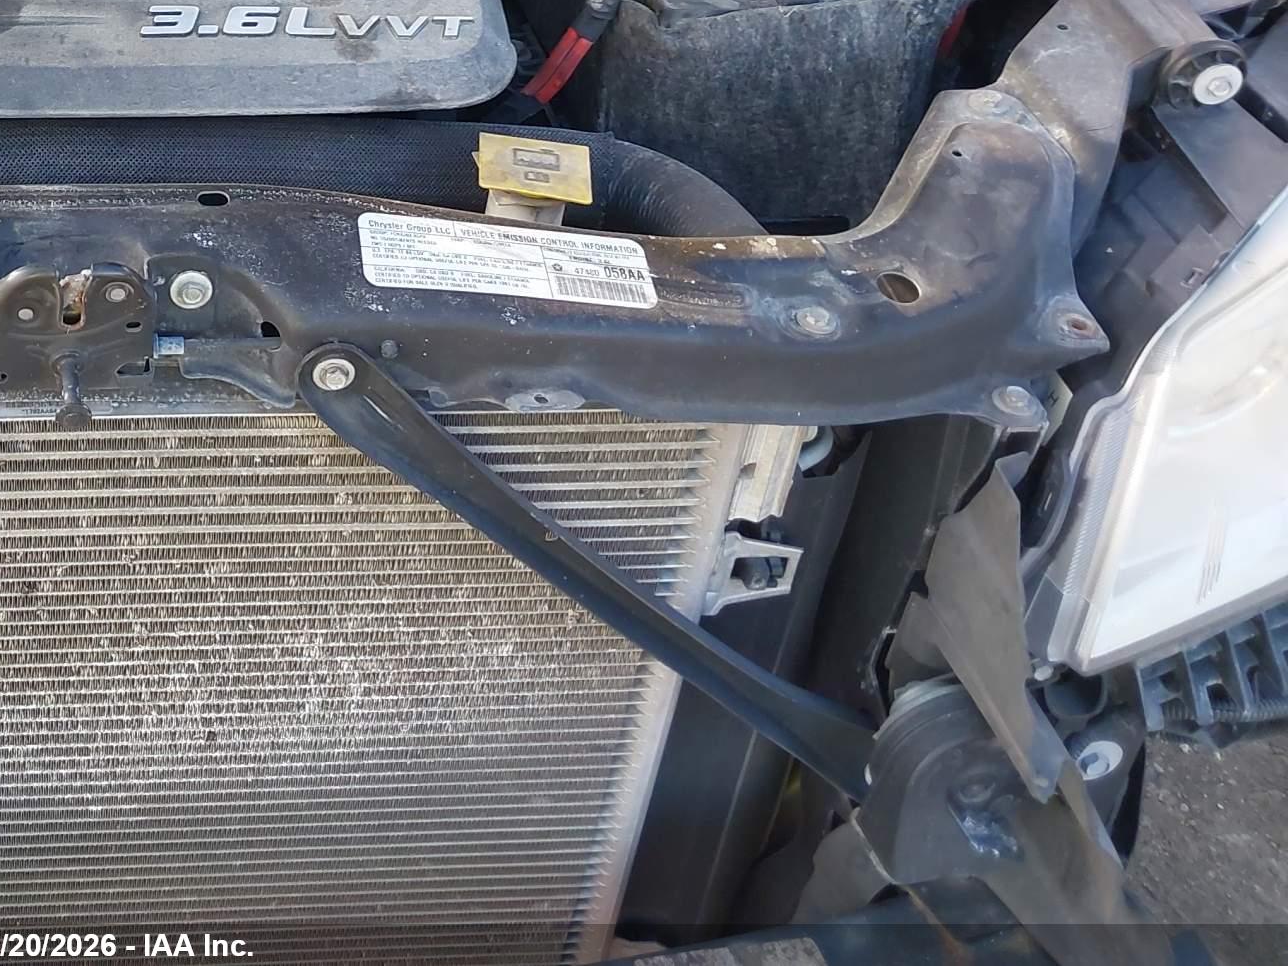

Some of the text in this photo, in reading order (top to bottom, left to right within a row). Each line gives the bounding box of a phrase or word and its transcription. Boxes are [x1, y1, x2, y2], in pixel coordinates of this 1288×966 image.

[140, 5, 476, 40] 3.6L VVT
[368, 220, 403, 230] Chrysler
[406, 223, 433, 234] Group
[435, 226, 451, 235] LLC
[461, 229, 496, 240] VEHICLE
[498, 233, 538, 244] EMISSION
[541, 237, 579, 248] CONTROL
[581, 241, 639, 254] INFORMATION
[604, 266, 646, 281] 058AA
